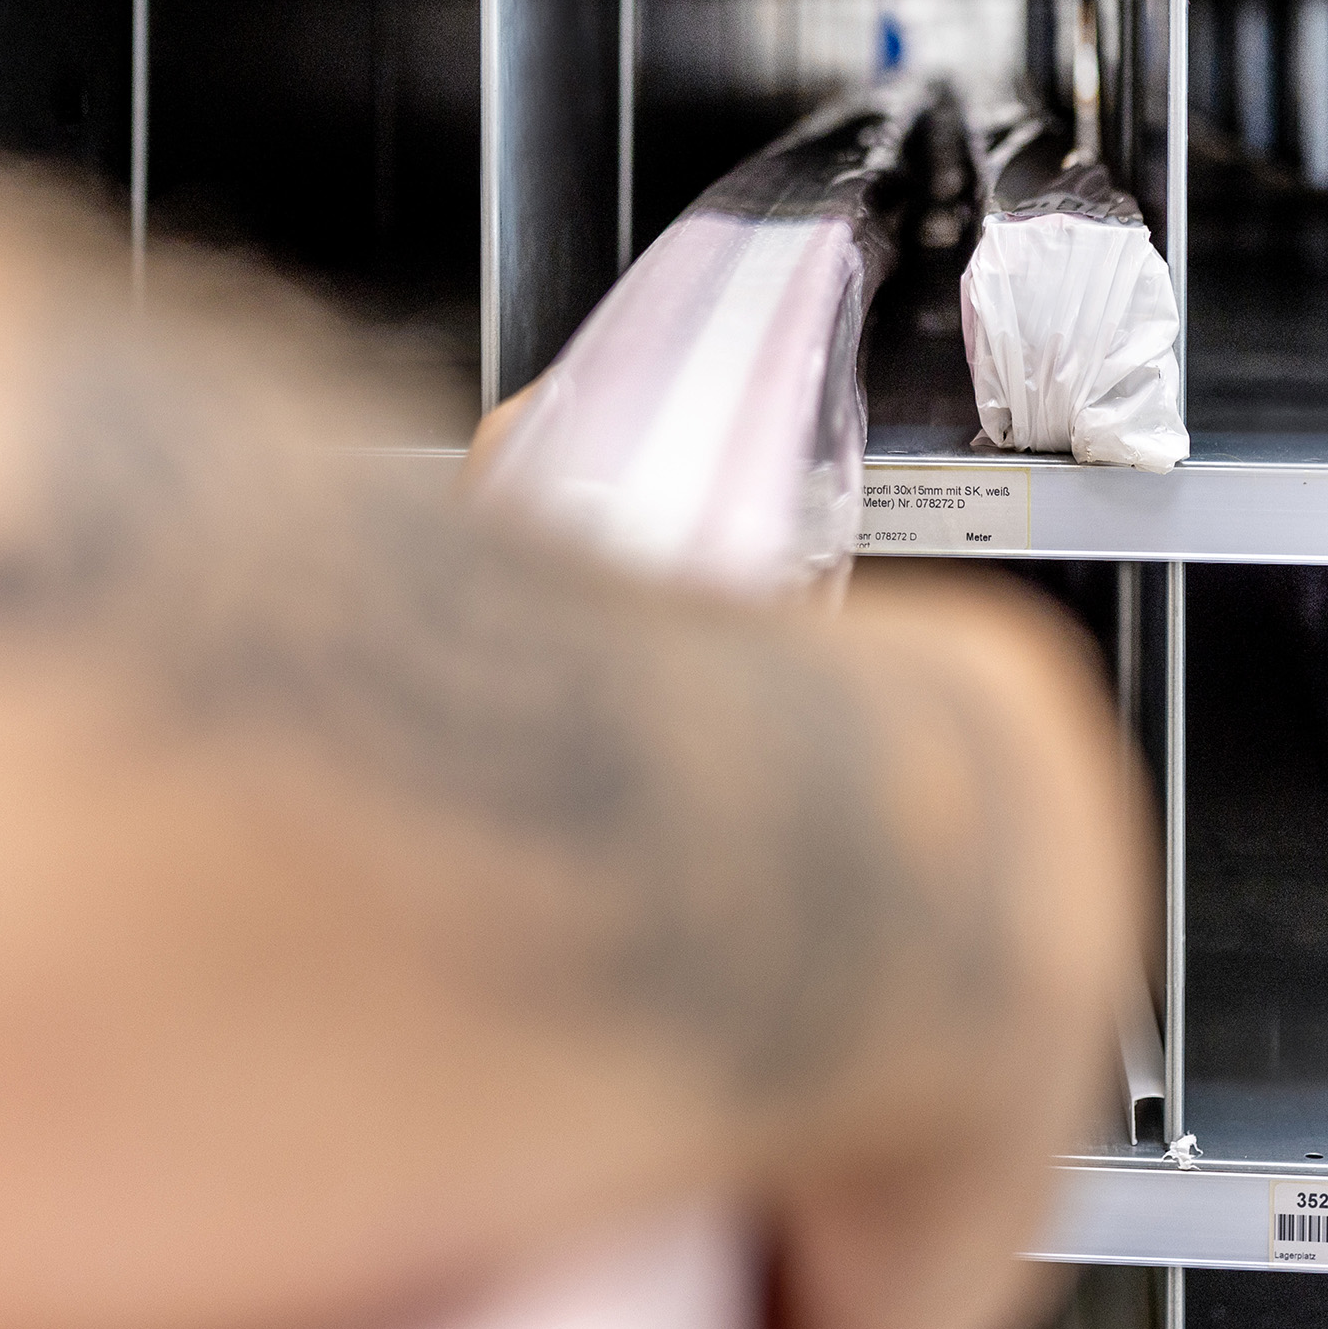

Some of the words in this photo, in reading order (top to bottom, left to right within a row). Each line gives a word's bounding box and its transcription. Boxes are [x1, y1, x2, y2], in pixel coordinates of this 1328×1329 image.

[862, 485, 891, 496] tprofil
[894, 486, 943, 496] 30x15mm
[946, 486, 961, 496] mit
[965, 487, 983, 498] SK,
[986, 487, 1010, 496] weiß
[863, 498, 894, 510] Meter)
[899, 498, 912, 508] Nr.
[916, 499, 954, 509] 078272
[957, 499, 965, 508] D
[875, 532, 907, 541] 078272
[910, 533, 917, 541] D
[966, 533, 992, 541] Meter
[1275, 1252, 1316, 1261] Lagerplatz
